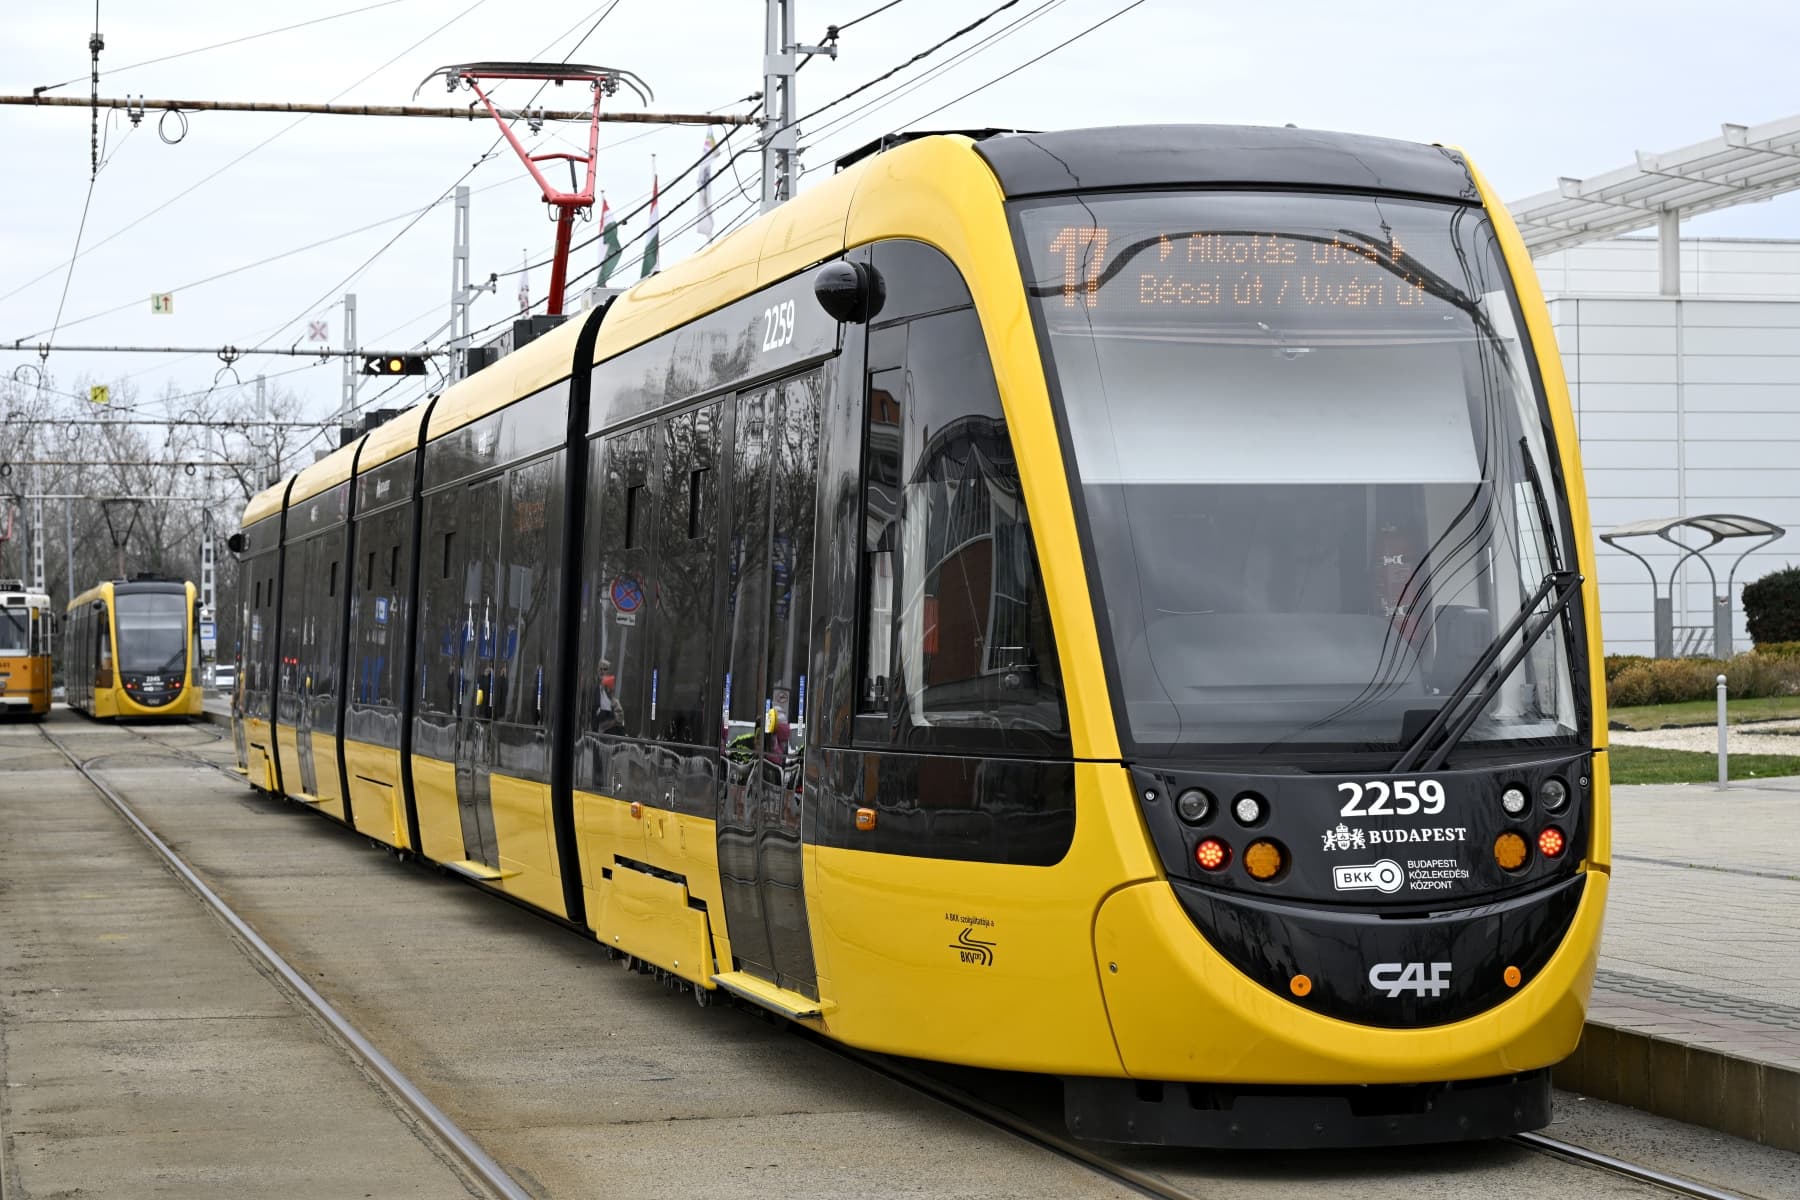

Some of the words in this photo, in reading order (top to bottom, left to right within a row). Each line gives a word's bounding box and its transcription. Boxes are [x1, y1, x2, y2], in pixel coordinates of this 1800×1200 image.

[1188, 233, 1298, 264] Alkotás
[1312, 235, 1378, 265] utca
[1050, 227, 1109, 307] 17
[1140, 272, 1221, 304] Bécsi
[1233, 271, 1263, 304] út
[1396, 272, 1425, 305] út
[763, 299, 795, 353] 2259
[1337, 779, 1446, 817] 2259
[1368, 828, 1467, 844] BUDAPEST
[1343, 872, 1373, 883] BKK
[1407, 859, 1457, 869] BUDAPESTI
[1408, 869, 1469, 879] KÖZLEKEDÉSI
[1410, 880, 1453, 890] KÖZPONT
[1368, 962, 1453, 998] CAF
